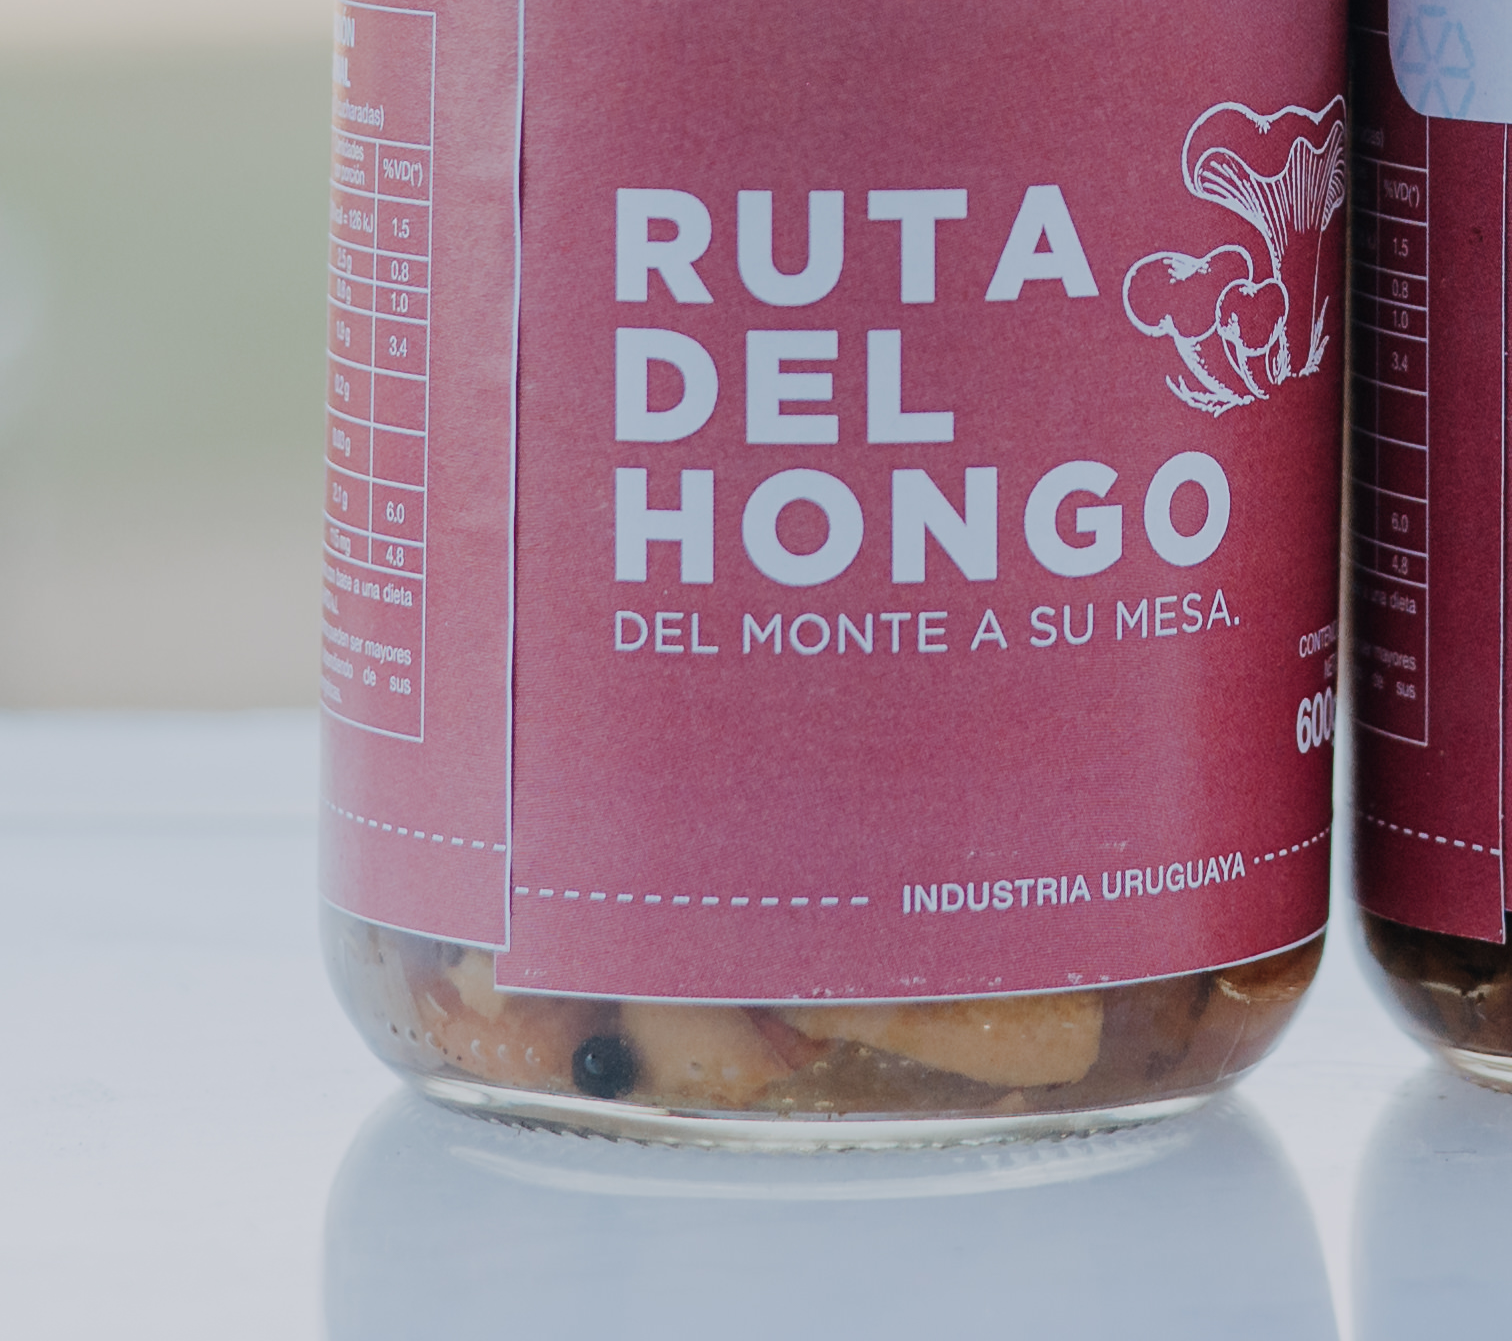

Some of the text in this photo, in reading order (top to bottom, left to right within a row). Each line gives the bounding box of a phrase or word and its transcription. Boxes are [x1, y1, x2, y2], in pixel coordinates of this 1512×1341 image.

[391, 218, 410, 238] 1.5
[616, 185, 1099, 306] RUTA
[1393, 237, 1409, 257] 1.5
[391, 261, 409, 281] 0.8
[1392, 279, 1409, 299] 0.8
[390, 293, 408, 313] 1.0
[1392, 310, 1408, 329] 1.0
[389, 336, 407, 357] 3.4
[1392, 352, 1408, 372] 3.4
[615, 328, 954, 444] DEL
[386, 502, 404, 524] 6.0
[615, 452, 1230, 586] HONGO
[1392, 512, 1408, 532] 6.0
[385, 546, 404, 567] 4.8
[1392, 555, 1408, 575] 4.8
[361, 582, 380, 601] una
[383, 582, 413, 607] dieta
[1390, 591, 1416, 614] dieta
[615, 589, 1239, 655] DEL MONTE A SU MESA.
[365, 637, 412, 665] mayores
[363, 666, 412, 695] de sus
[1396, 680, 1416, 700] sus
[1296, 685, 1336, 754] 600
[903, 852, 1245, 914] INDUSTRIA URUGUAYA
